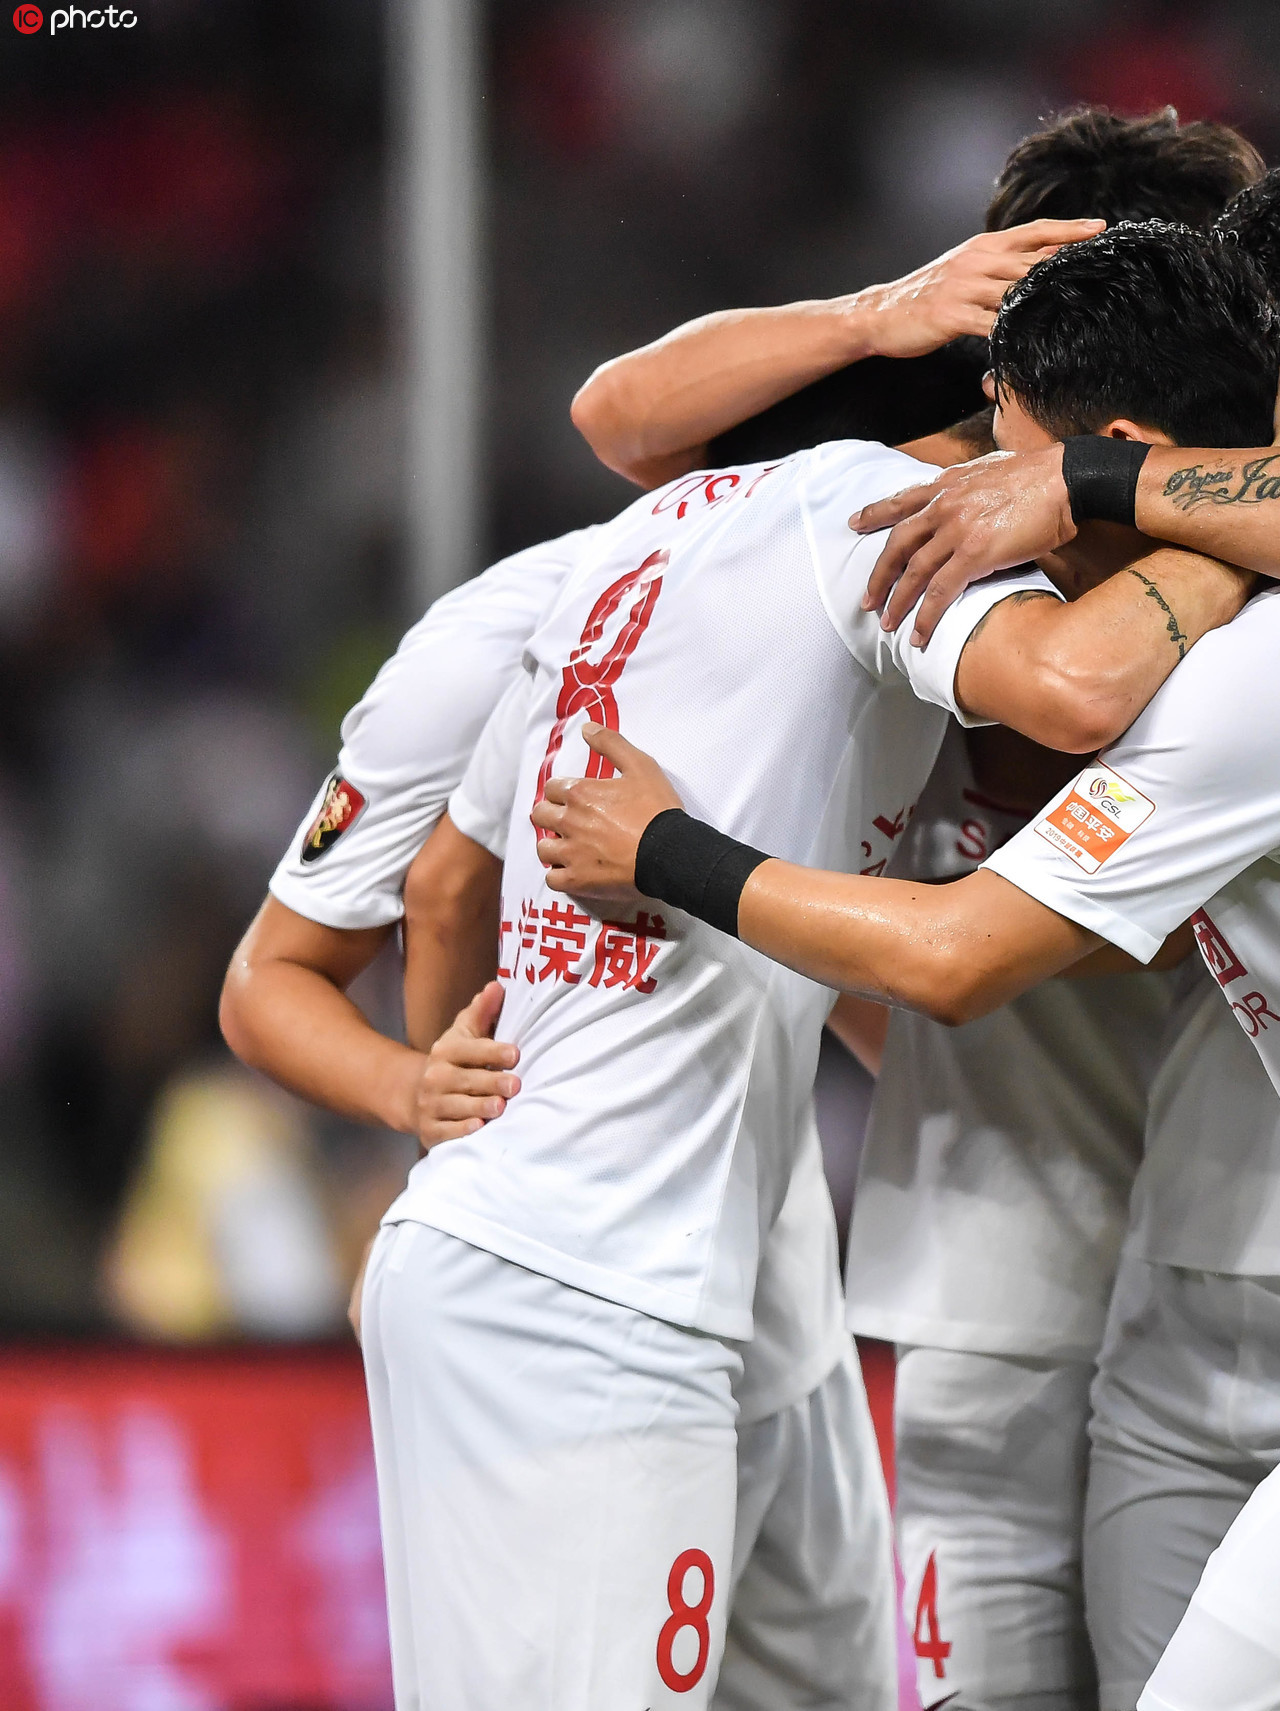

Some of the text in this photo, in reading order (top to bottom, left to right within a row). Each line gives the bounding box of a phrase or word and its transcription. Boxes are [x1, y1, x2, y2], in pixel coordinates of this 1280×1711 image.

[1065, 801, 1116, 842] 中国平安
[1101, 800, 1122, 819] CSL
[656, 1548, 715, 1693] 8
[913, 1547, 953, 1679] 4
